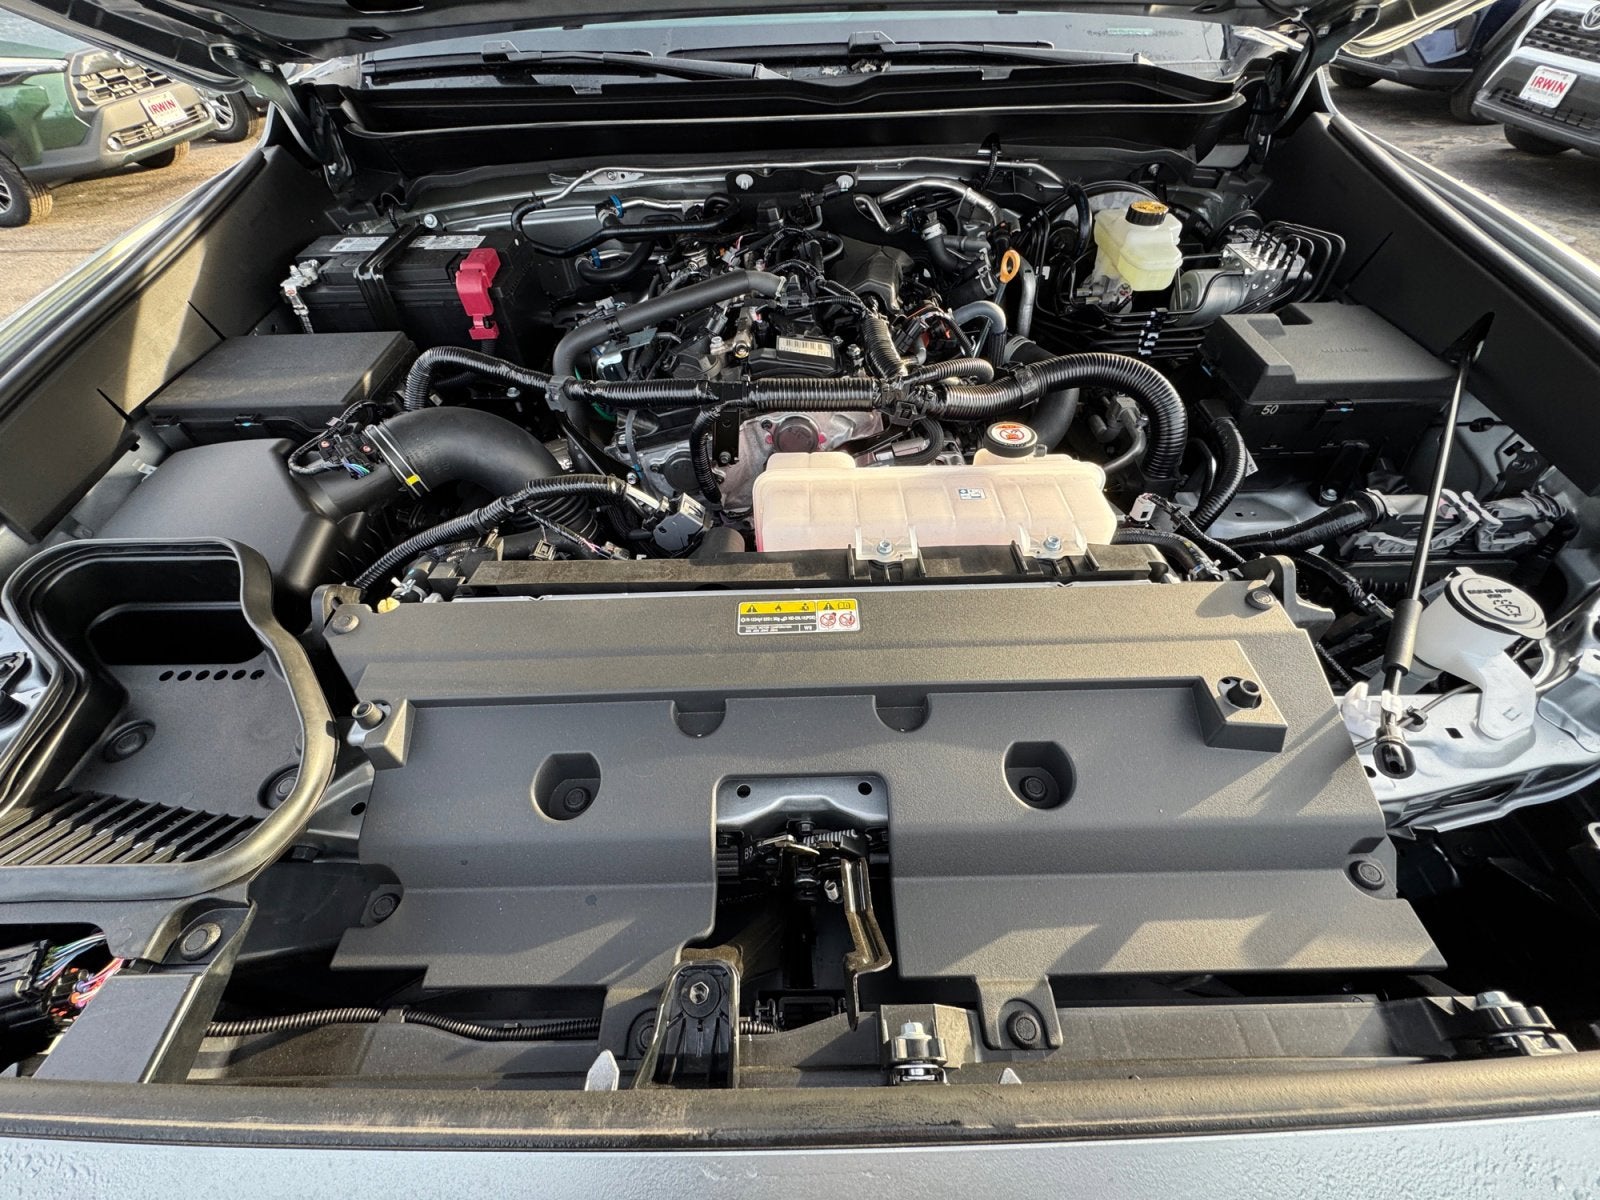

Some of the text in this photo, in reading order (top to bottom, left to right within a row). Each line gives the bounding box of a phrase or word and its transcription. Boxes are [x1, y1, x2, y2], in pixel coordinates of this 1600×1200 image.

[1530, 75, 1568, 93] IRWIN
[148, 99, 176, 114] IRWIN
[1261, 404, 1279, 415] 50
